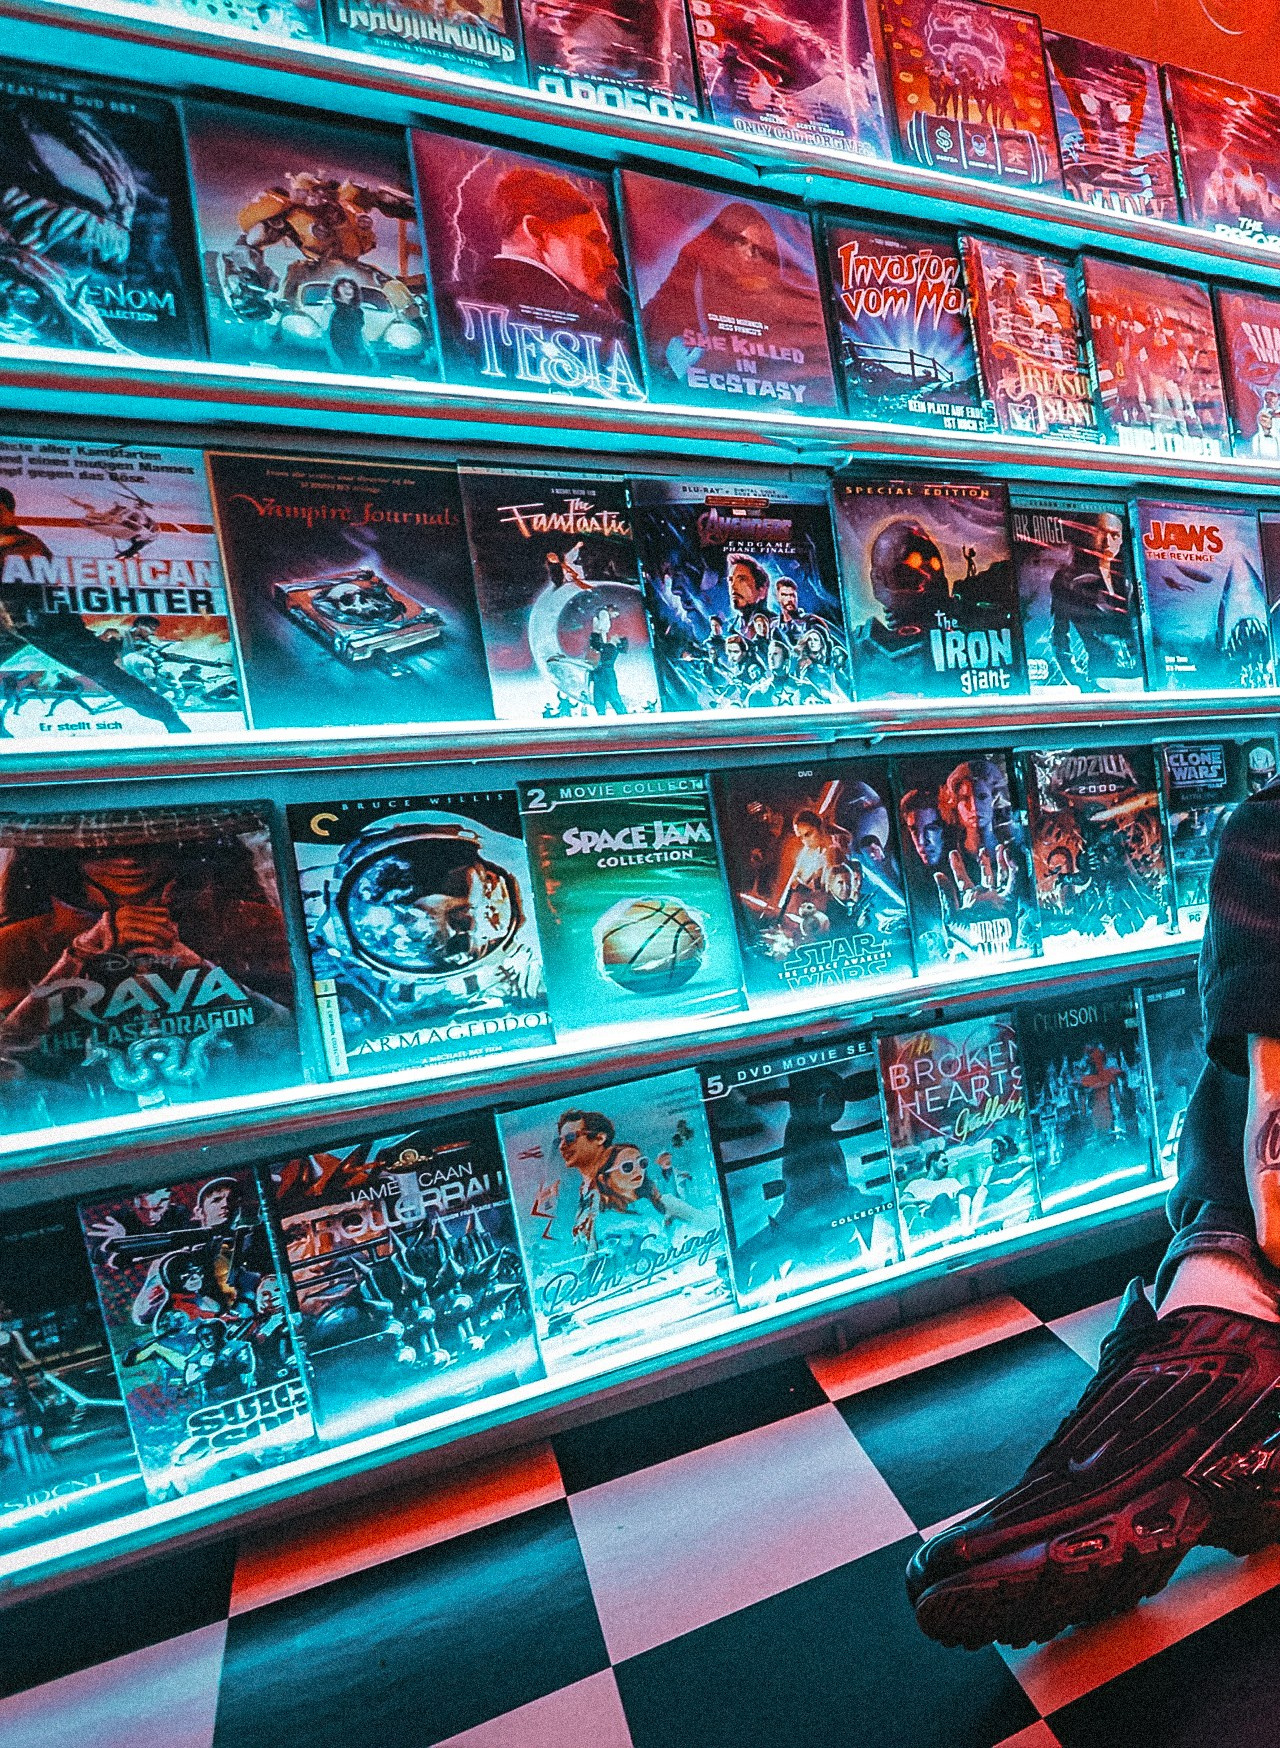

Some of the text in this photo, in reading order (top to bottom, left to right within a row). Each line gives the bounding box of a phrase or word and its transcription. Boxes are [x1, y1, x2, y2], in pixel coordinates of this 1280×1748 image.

[0, 82, 67, 102] EATURE
[733, 117, 771, 137] ONLY
[1238, 216, 1263, 232] THE
[837, 240, 960, 292] Invasion
[66, 274, 177, 317] VENOM
[842, 279, 968, 332] vom Ma
[683, 327, 805, 364] SHE KILLED
[736, 359, 757, 375] IN
[687, 366, 807, 403] ECSTASY
[926, 401, 950, 416] PLATZ
[27, 456, 69, 468] eines
[138, 461, 195, 475] Mannes
[27, 469, 75, 480] gegen
[78, 470, 105, 482] das
[845, 486, 991, 498] SPECIAL EDITION
[227, 493, 459, 528] Vampire Journals
[497, 502, 634, 540] Fantastic
[1031, 515, 1068, 545] ANGEL
[1143, 519, 1224, 555] JAWS
[723, 546, 797, 555] PHASE FINALE
[728, 541, 792, 549] ENDGAME
[1146, 551, 1215, 563] THE REVENGE
[1, 554, 221, 588] AMERICAN
[45, 586, 217, 615] FIGHTER
[934, 609, 959, 629] the
[929, 628, 1014, 672] IRON
[960, 668, 1011, 695] giant
[38, 720, 123, 732] Er stellt sich
[1168, 750, 1224, 768] CLONE
[797, 769, 814, 778] DVD
[1171, 765, 1221, 782] WARS
[340, 793, 504, 812] BRUCE WILLIS
[526, 778, 704, 809] 2 MOVIE COLLECTI
[1077, 783, 1117, 794] 2000
[561, 820, 713, 856] SPACE JAM
[597, 849, 694, 869] COLLECTION
[1188, 911, 1202, 923] PG
[777, 951, 892, 980] THE FORCE AWAKENS
[785, 932, 886, 971] STAR
[30, 966, 250, 1025] RAYA
[39, 1006, 255, 1054] THE LAST DRAGON
[1033, 1004, 1098, 1032] CRIMSON
[706, 1041, 868, 1095] 5 DVD MOVIE SE
[897, 1064, 1024, 1119] HEARTS
[954, 1094, 1026, 1142] Gallery
[349, 1162, 474, 1206] JAME CAAN
[831, 1202, 895, 1227] COLLECTIO
[542, 1225, 724, 1318] Palm Spring
